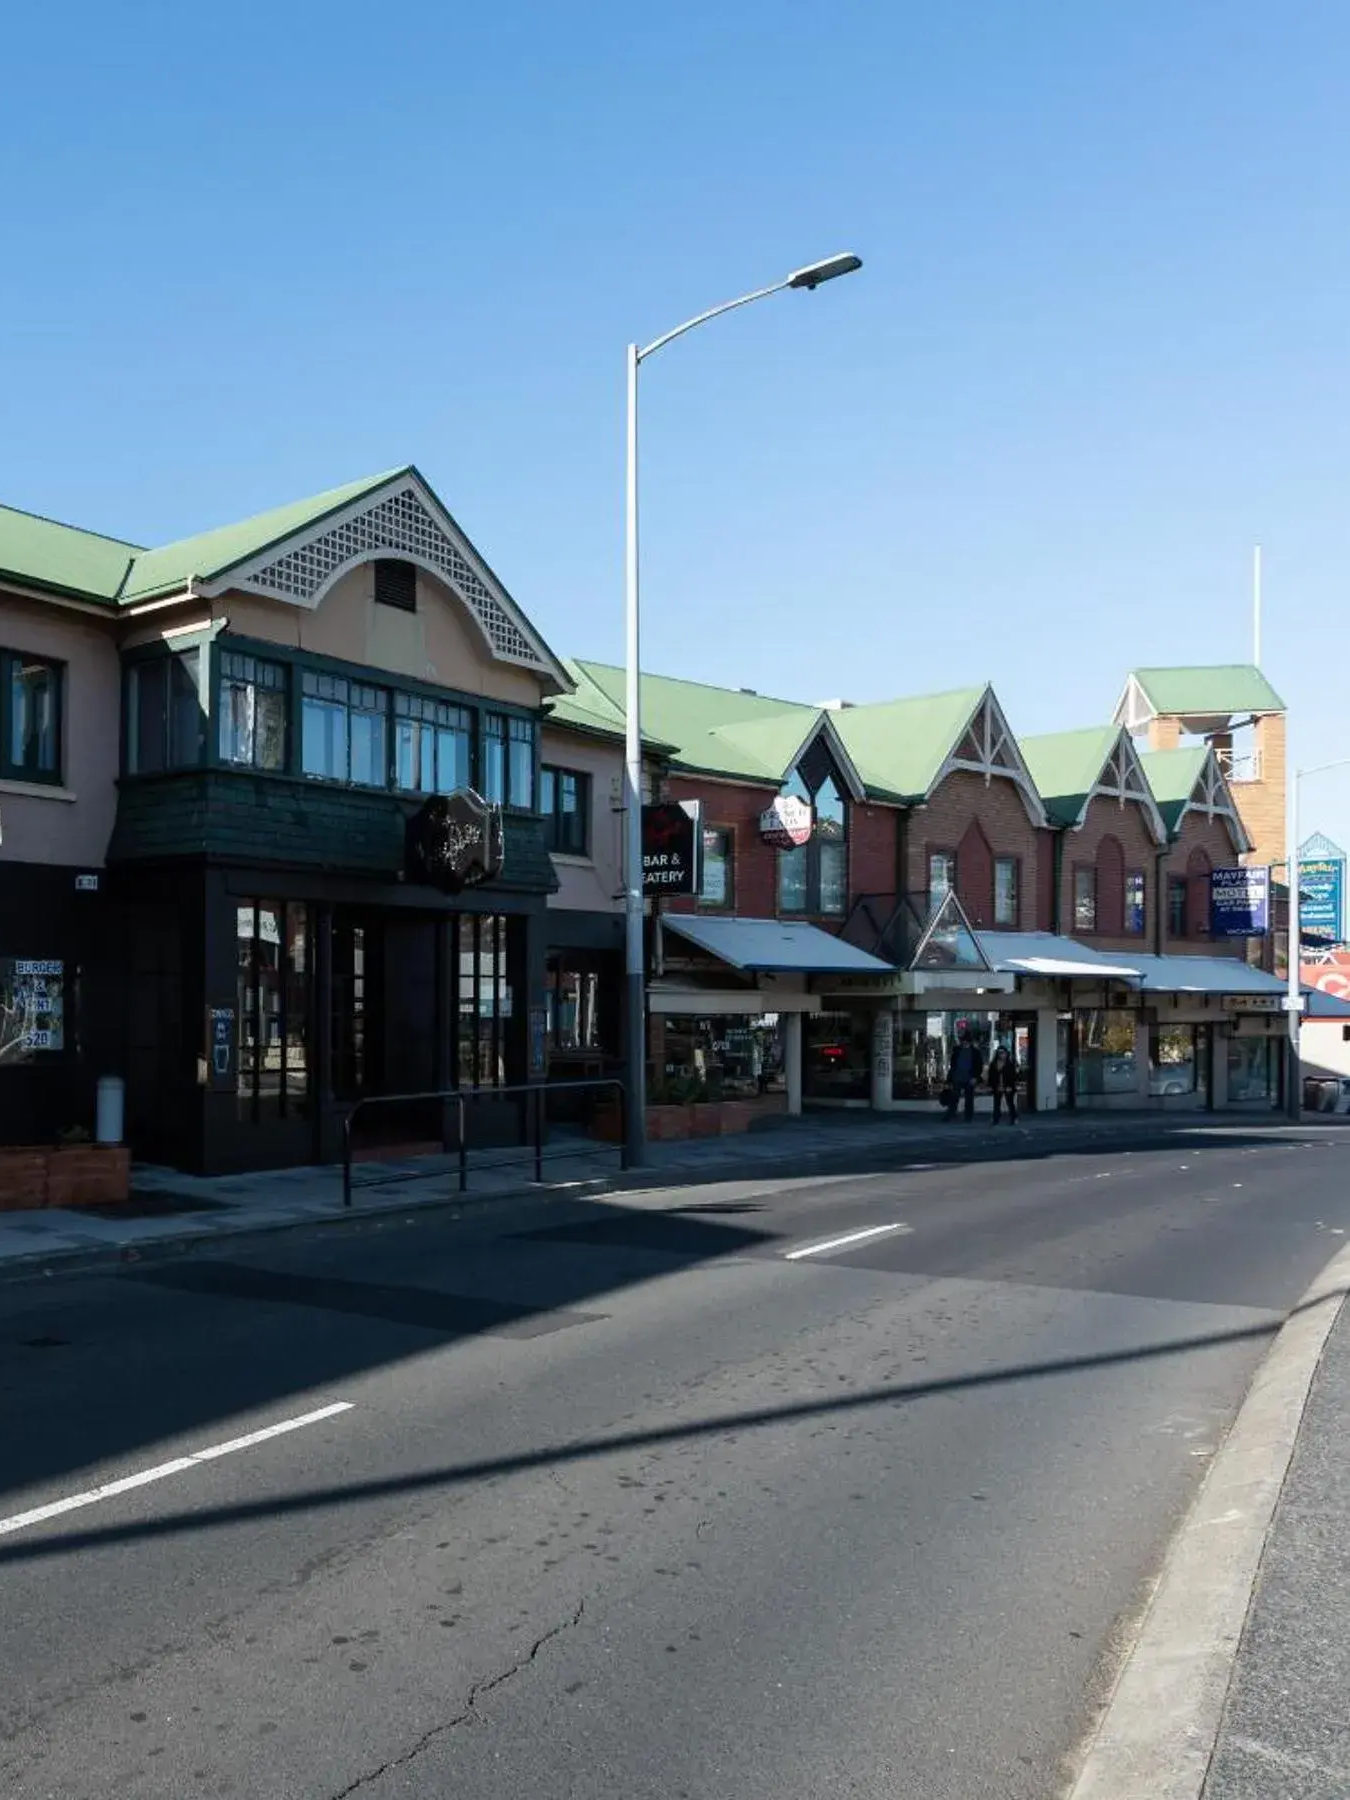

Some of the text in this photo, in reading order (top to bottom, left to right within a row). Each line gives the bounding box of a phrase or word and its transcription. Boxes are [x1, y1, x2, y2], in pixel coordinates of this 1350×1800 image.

[643, 852, 681, 867] BAR &
[1213, 870, 1265, 880] MAYFAIR
